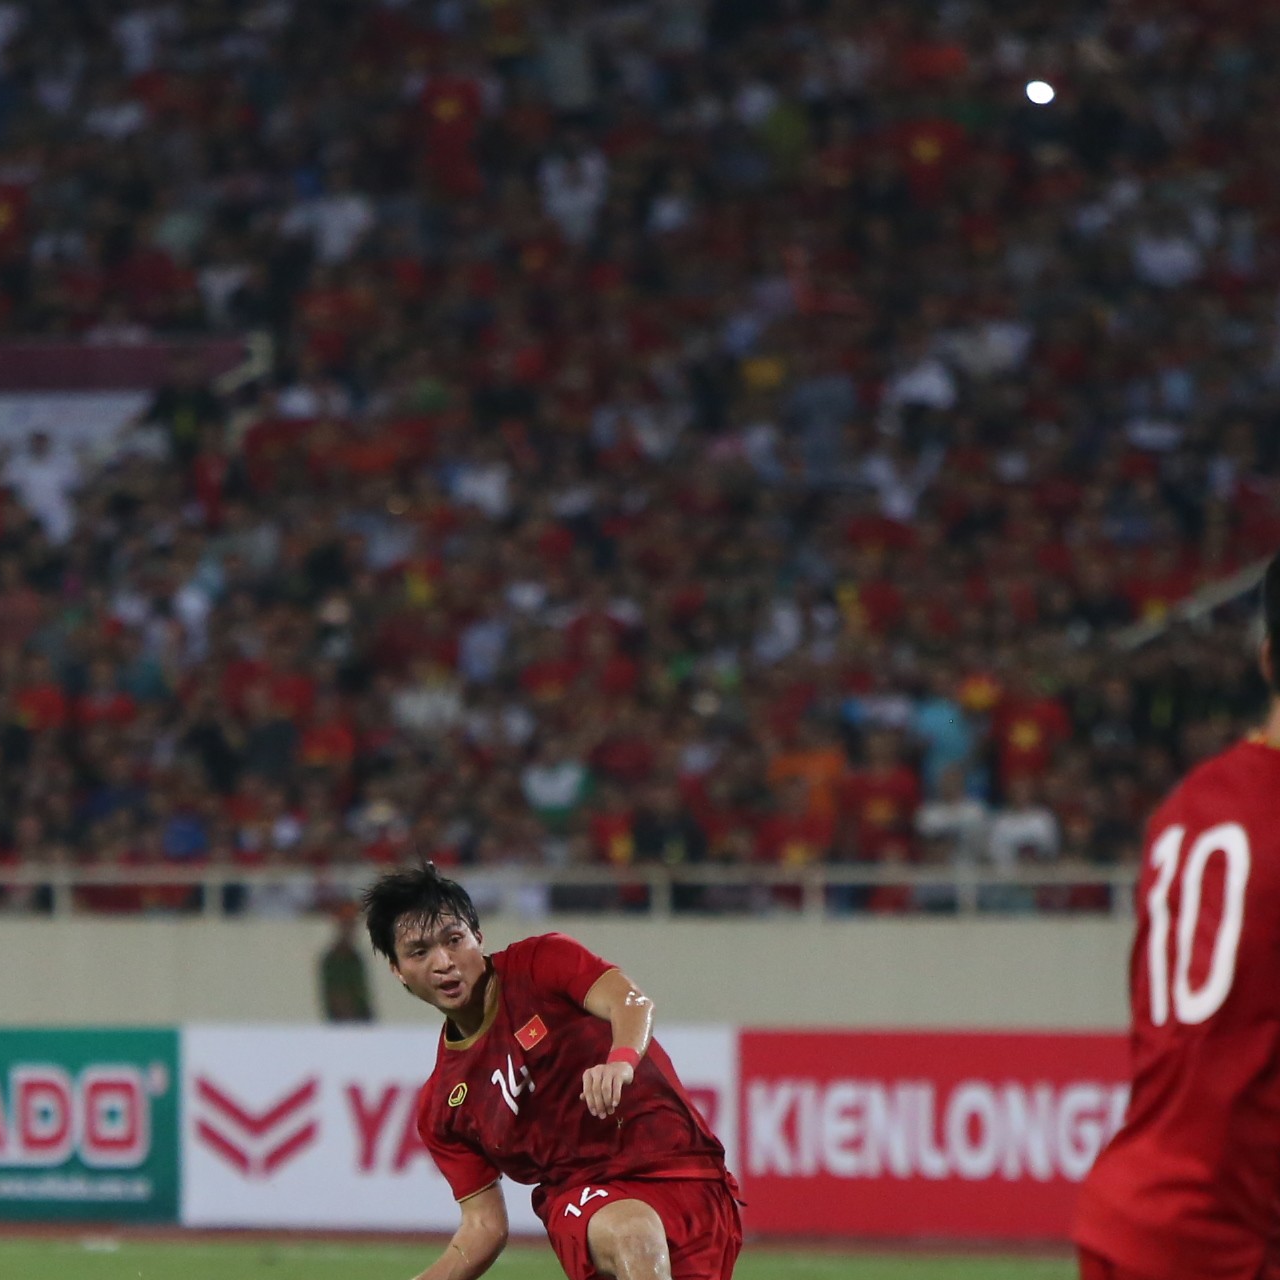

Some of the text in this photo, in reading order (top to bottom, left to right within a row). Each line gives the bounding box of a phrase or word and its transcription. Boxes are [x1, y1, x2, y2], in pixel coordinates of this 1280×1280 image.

[1147, 821, 1251, 1027] 10
[491, 1054, 536, 1116] 14
[564, 1187, 609, 1217] 14
